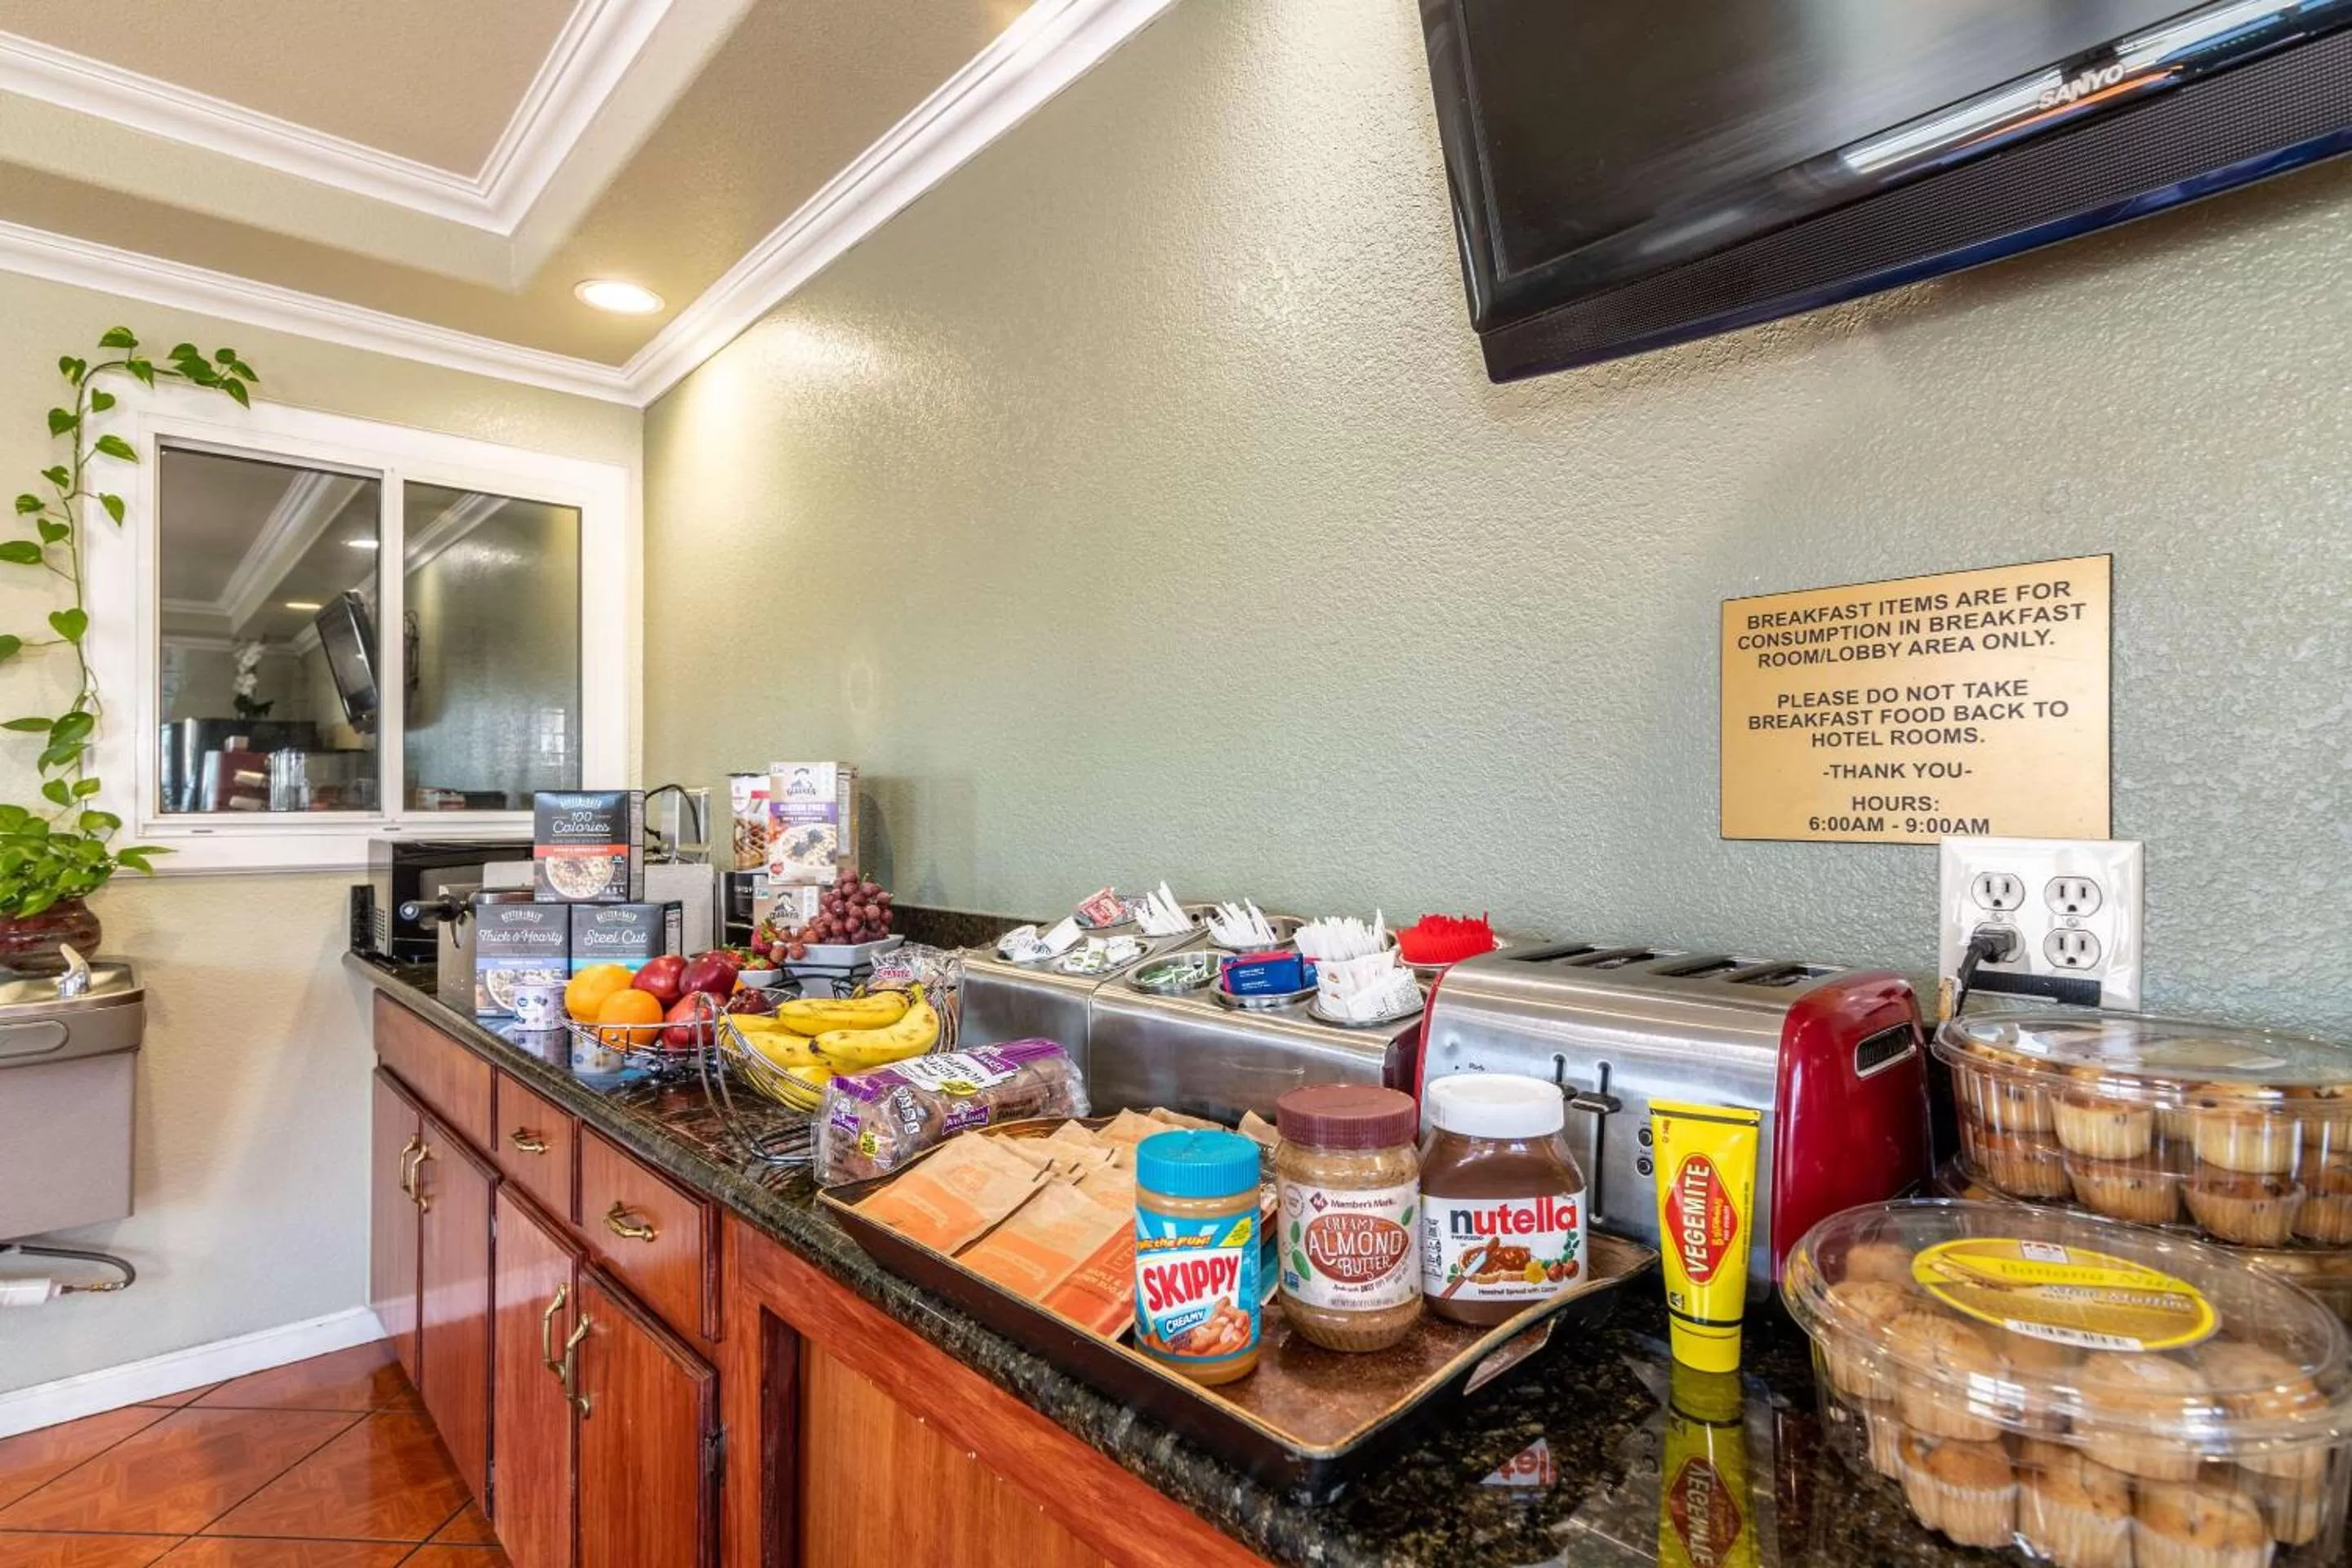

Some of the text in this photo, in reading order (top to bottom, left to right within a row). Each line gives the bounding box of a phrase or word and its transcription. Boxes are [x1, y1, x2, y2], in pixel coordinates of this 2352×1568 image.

[2038, 64, 2124, 106] SANYO
[1748, 581, 2071, 629] BREAKFAST ITEMS ARE FOR
[1738, 604, 2087, 650] CONSUMPTION IN BREAKFAST
[1758, 630, 2055, 668] ROOM/LOBBY AREA ONLY.
[1778, 679, 2028, 709] PLEASE DO NOT TAKE
[1748, 701, 2069, 729] BREAKFAST FOOD BACK TO
[1811, 728, 1985, 747] HOTEL ROOMS.
[572, 811, 592, 822] 100
[1852, 796, 1940, 813] HOURS:
[553, 819, 611, 833] Calories
[1809, 817, 1885, 832] 6:00AM
[1906, 817, 1990, 834] 9:00AM
[478, 929, 510, 942] Thick
[521, 930, 563, 946] Hearty
[584, 929, 648, 946] Steel Cut
[1331, 1199, 1395, 1209] Member's Mark
[1450, 1195, 1577, 1235] nutella
[1325, 1217, 1375, 1231] CREAMY
[1682, 1163, 1711, 1273] VEGEMITE
[1309, 1229, 1402, 1265] ALMOND
[1338, 1256, 1392, 1277] BUTTER
[1143, 1255, 1239, 1311] SKIPPY
[1166, 1307, 1206, 1333] CREAMY
